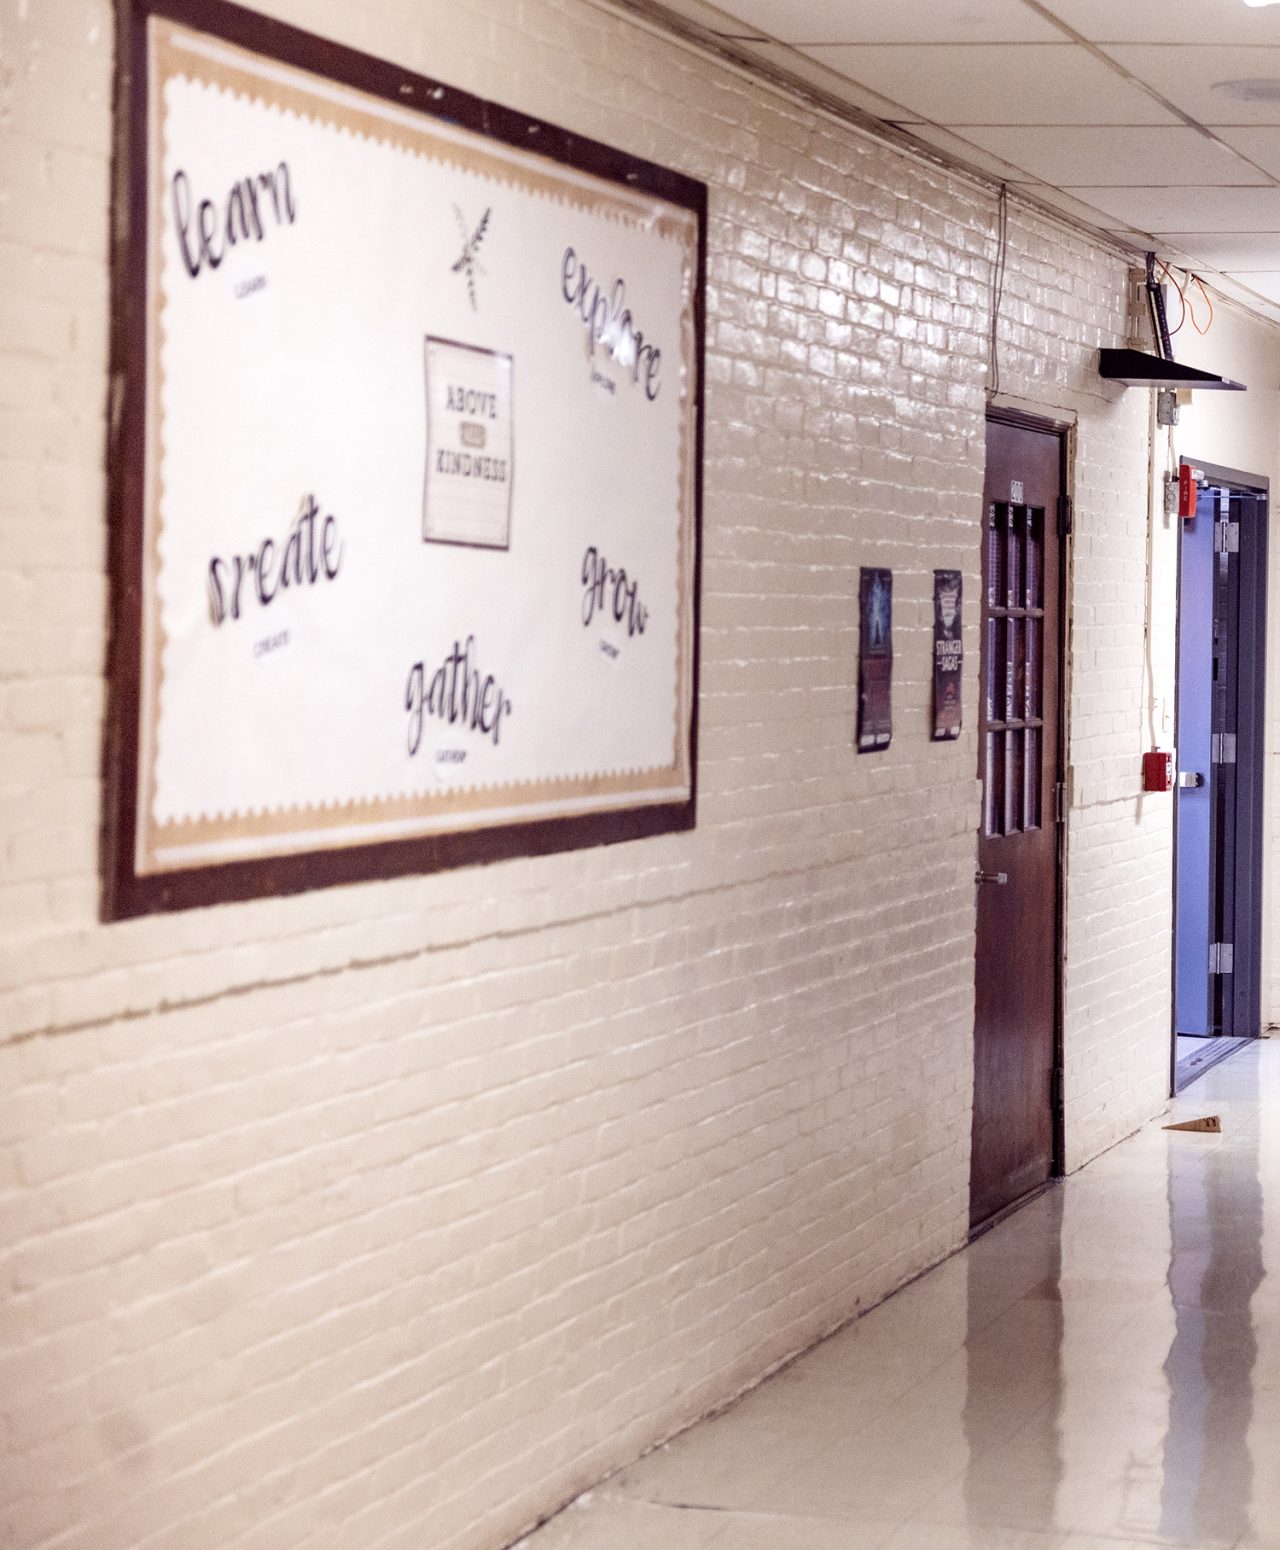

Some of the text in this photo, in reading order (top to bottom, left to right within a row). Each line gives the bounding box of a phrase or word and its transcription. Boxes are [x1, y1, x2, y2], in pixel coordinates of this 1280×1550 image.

[172, 162, 295, 279] learn
[446, 385, 497, 419] ABOVE
[437, 449, 507, 482] KINDNESS
[581, 546, 649, 637] grow
[936, 640, 962, 656] STRANGER
[405, 634, 512, 757] gather
